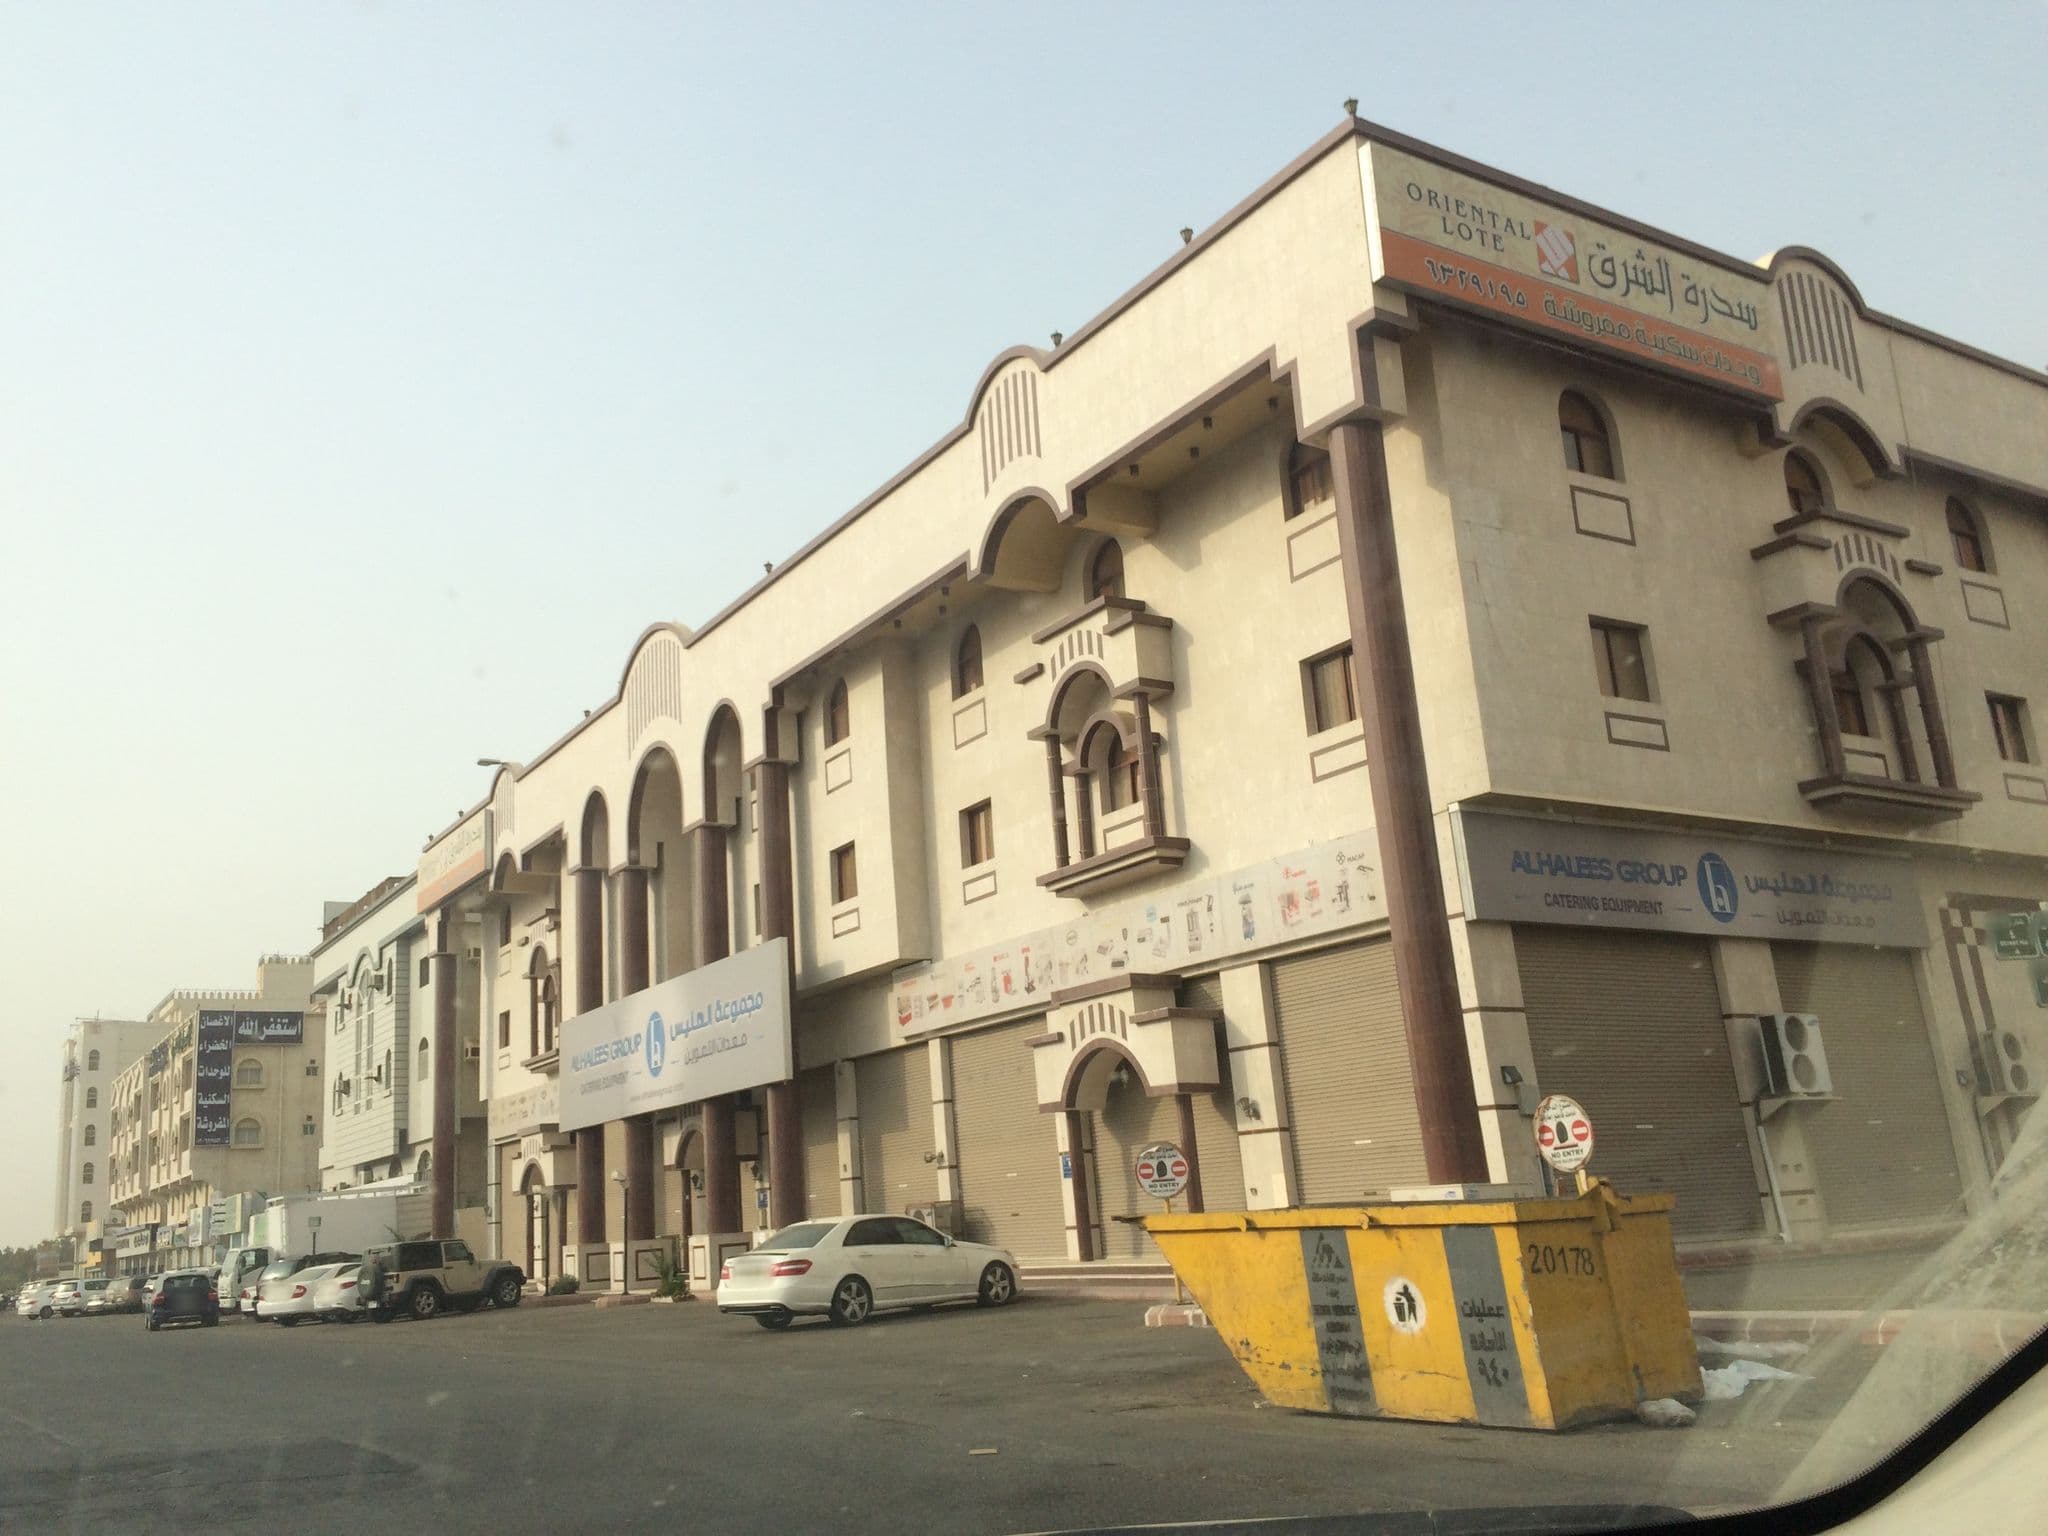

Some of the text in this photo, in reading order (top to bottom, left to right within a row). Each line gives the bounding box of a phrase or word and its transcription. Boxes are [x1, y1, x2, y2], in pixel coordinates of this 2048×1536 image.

[1406, 182, 1533, 242] ORIENTAL
[1441, 214, 1506, 254] LOTE
[1588, 241, 1759, 332] سدرة الشرق
[1543, 292, 1634, 342] مفروشة
[1635, 320, 1702, 365] سكنية
[1703, 346, 1763, 387] وحدات
[1511, 849, 1688, 888] ALHALEES GROUP
[1544, 892, 1663, 915] CATERING EQUIPMENT
[714, 991, 765, 1024] مجموعة
[237, 1016, 259, 1036] الله
[610, 1032, 642, 1061] GROUP
[1551, 1148, 1584, 1159] NO ENTRY
[1528, 1243, 1596, 1276] 20178
[1461, 1298, 1505, 1324] عمليات
